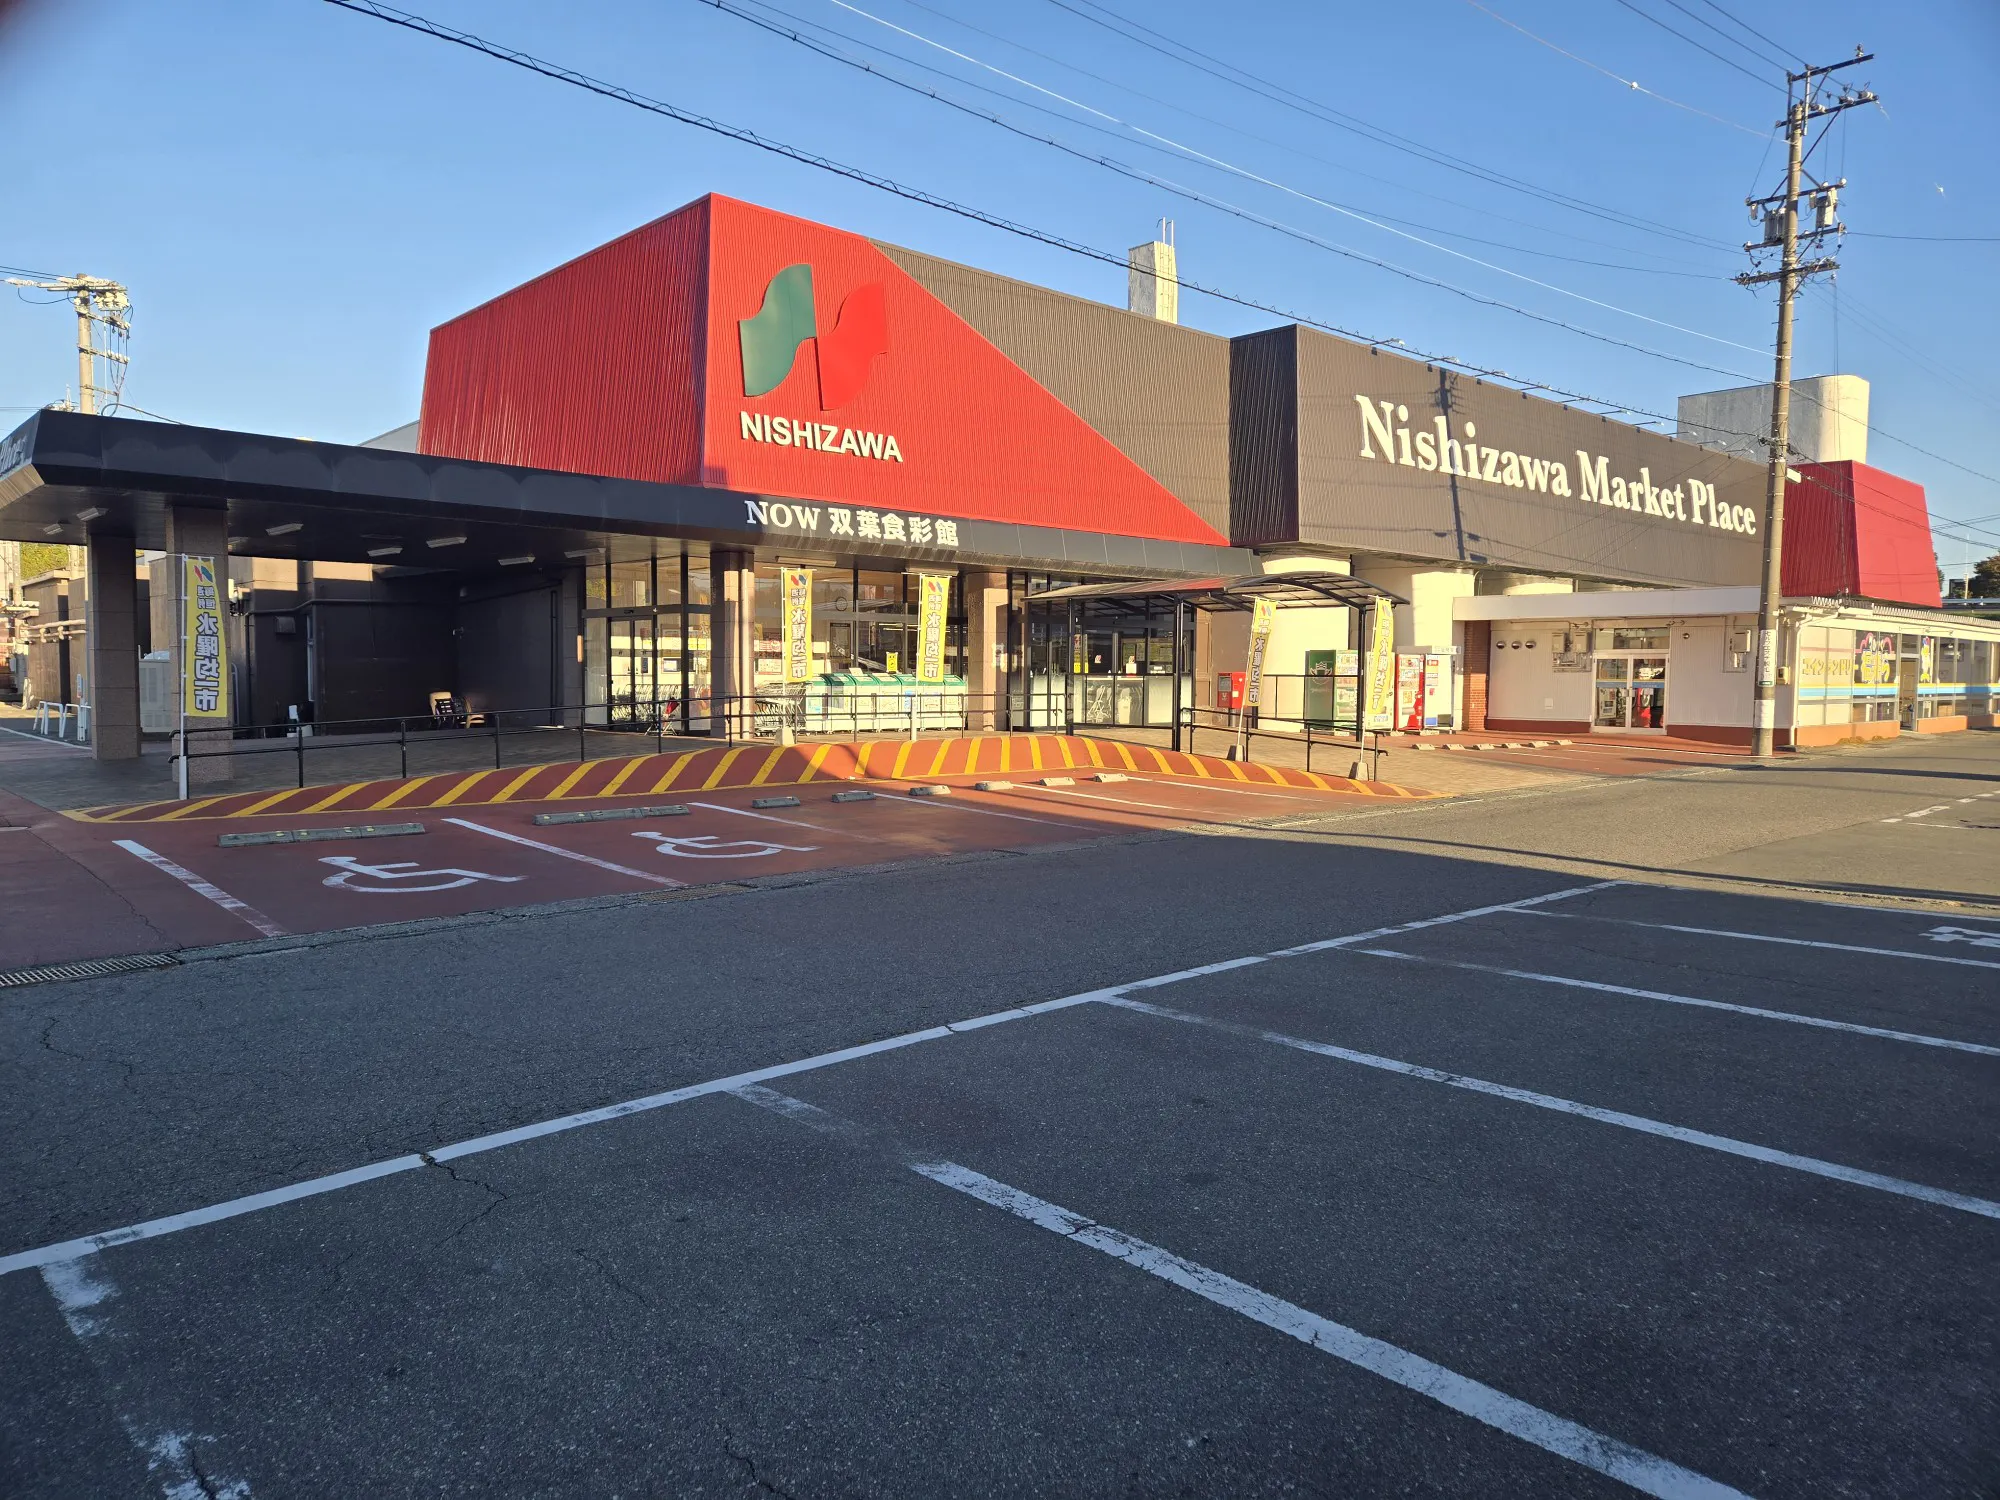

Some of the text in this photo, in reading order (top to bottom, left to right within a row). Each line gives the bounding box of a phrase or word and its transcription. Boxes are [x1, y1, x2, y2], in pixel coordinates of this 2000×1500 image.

[740, 411, 904, 463] NISHIZAWA
[1355, 394, 1757, 535] Nishizawa Market Place
[744, 500, 959, 546] NOW 双葉食彩館
